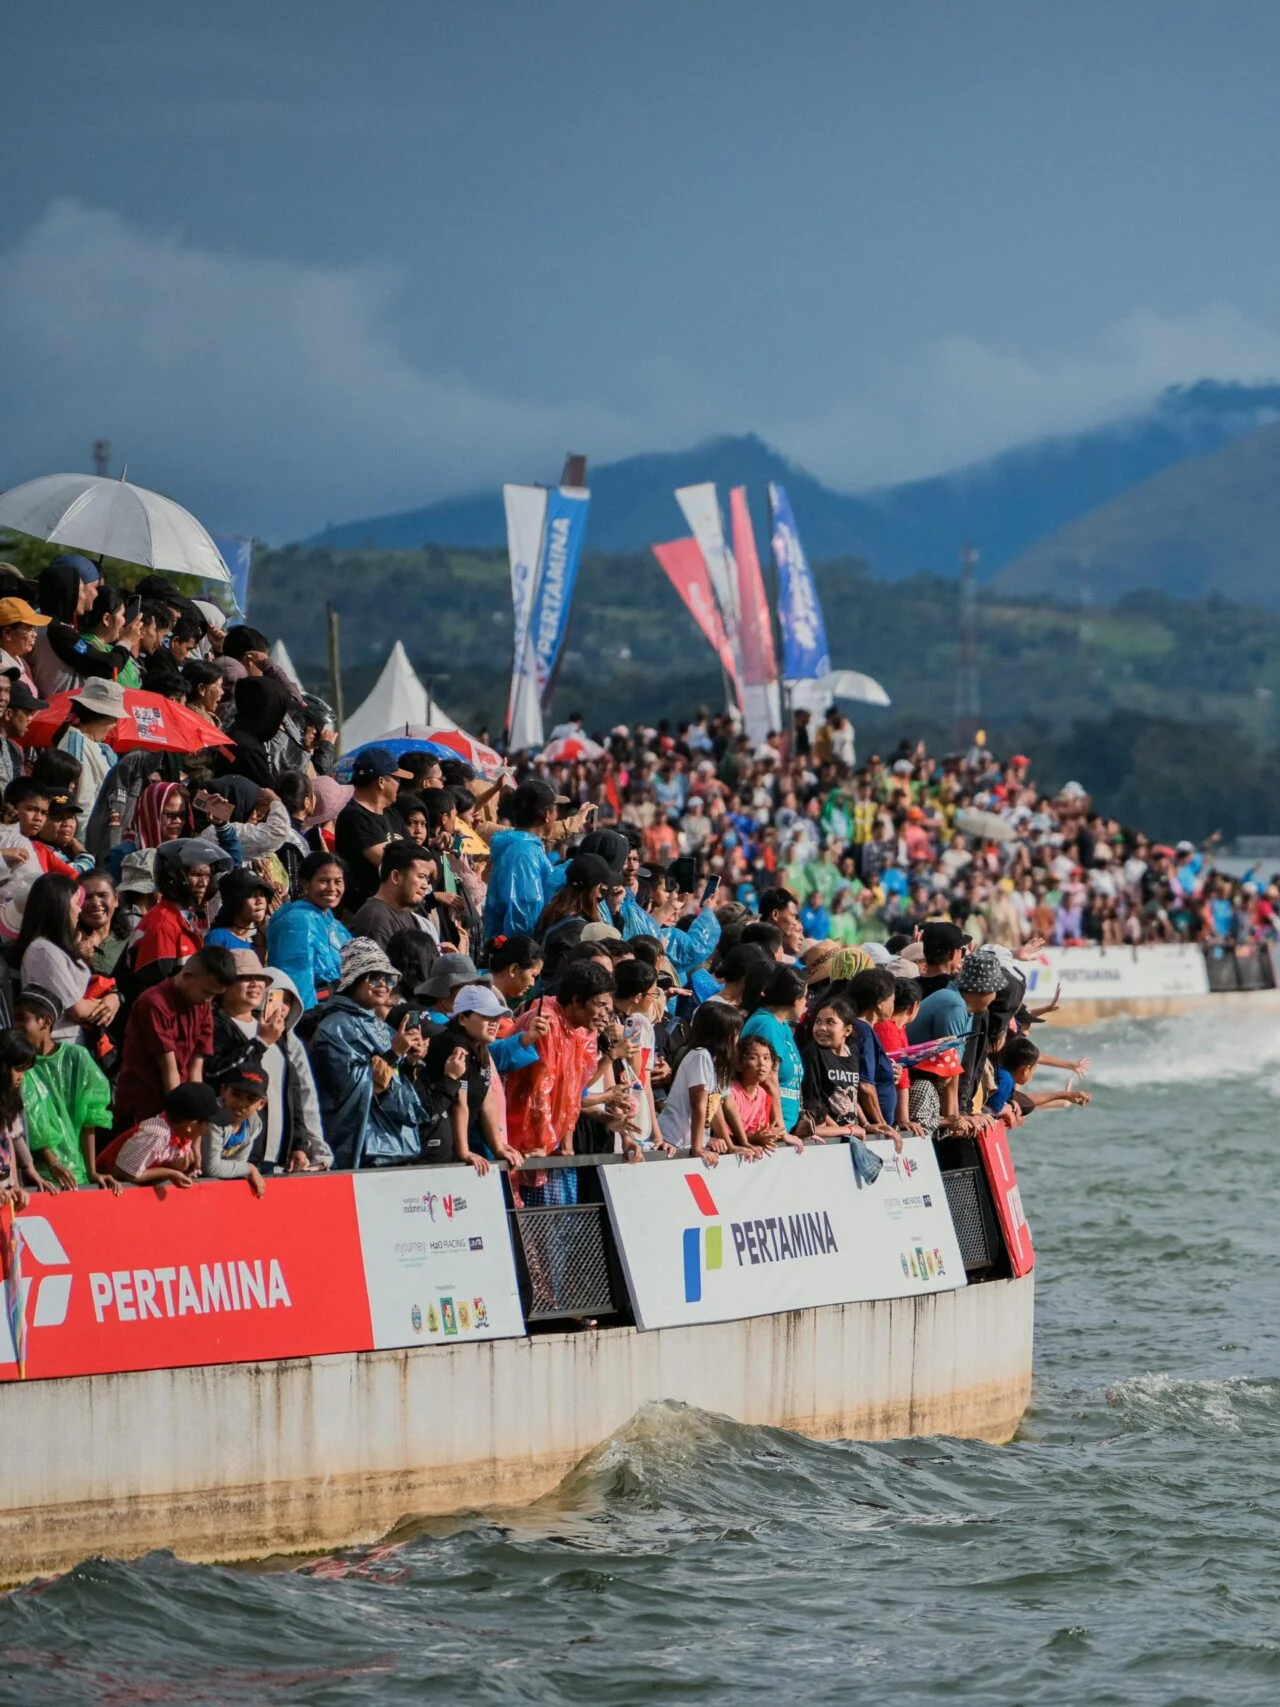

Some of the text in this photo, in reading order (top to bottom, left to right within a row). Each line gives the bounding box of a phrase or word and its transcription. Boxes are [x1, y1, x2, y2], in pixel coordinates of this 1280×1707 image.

[537, 518, 570, 655] PERTAMINA
[731, 1211, 838, 1267] PERTAMINA
[89, 1259, 292, 1323] PERTAMINA
